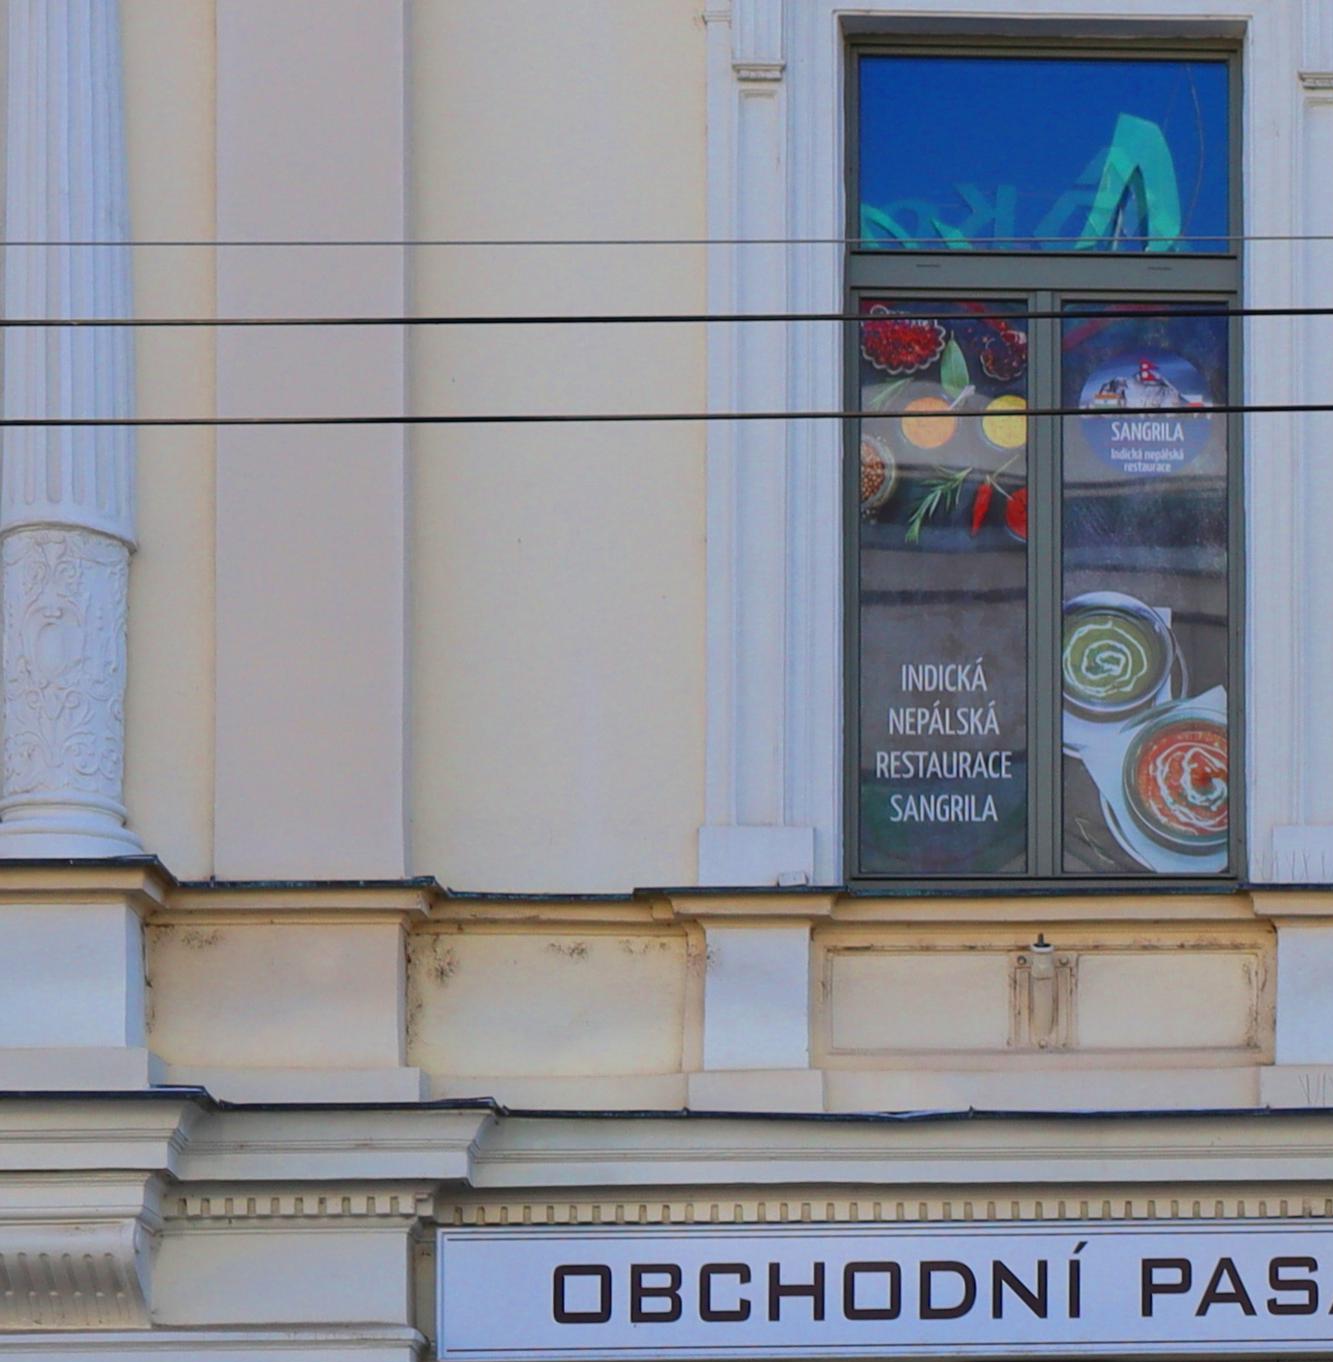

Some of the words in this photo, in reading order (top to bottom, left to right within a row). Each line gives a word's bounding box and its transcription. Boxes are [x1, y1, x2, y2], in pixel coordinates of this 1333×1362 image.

[1111, 422, 1184, 442] SANGRILA
[1124, 462, 1171, 472] restaurace
[901, 657, 987, 691] INDICKÁ
[888, 700, 999, 735] NEPÁLSKÁ
[876, 751, 1012, 779] RESTAURACE
[890, 794, 998, 821] SANGRILA
[553, 1241, 1087, 1323] OBCHODNÍ
